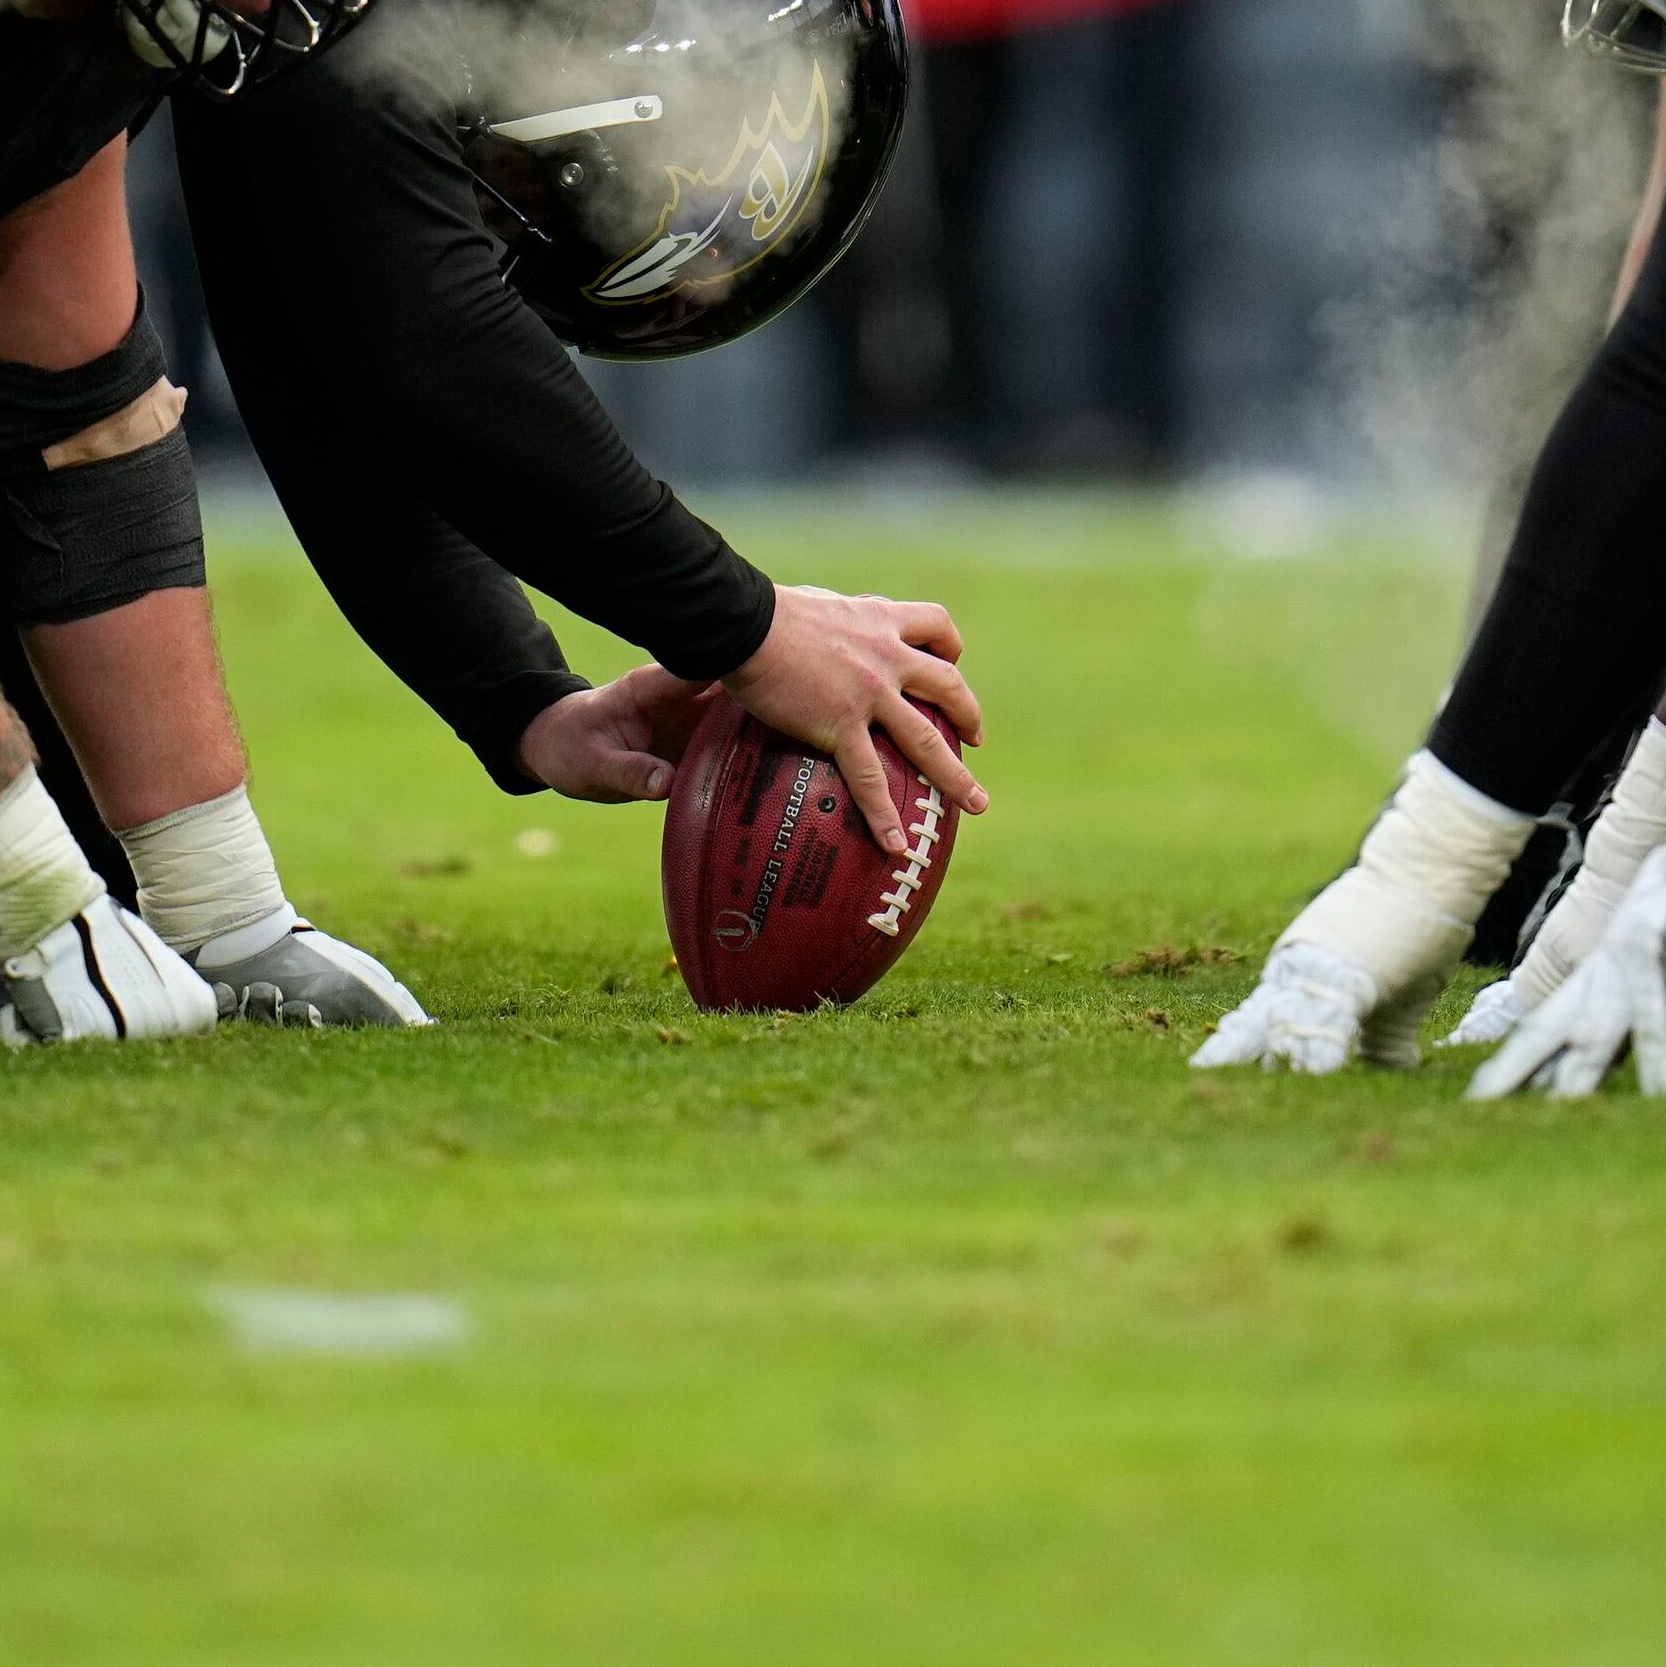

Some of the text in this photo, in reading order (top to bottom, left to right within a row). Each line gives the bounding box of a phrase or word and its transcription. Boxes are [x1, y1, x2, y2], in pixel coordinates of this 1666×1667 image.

[738, 141, 815, 241] B
[772, 756, 816, 852] FOOTBALL
[747, 858, 782, 931] LEAGUE
